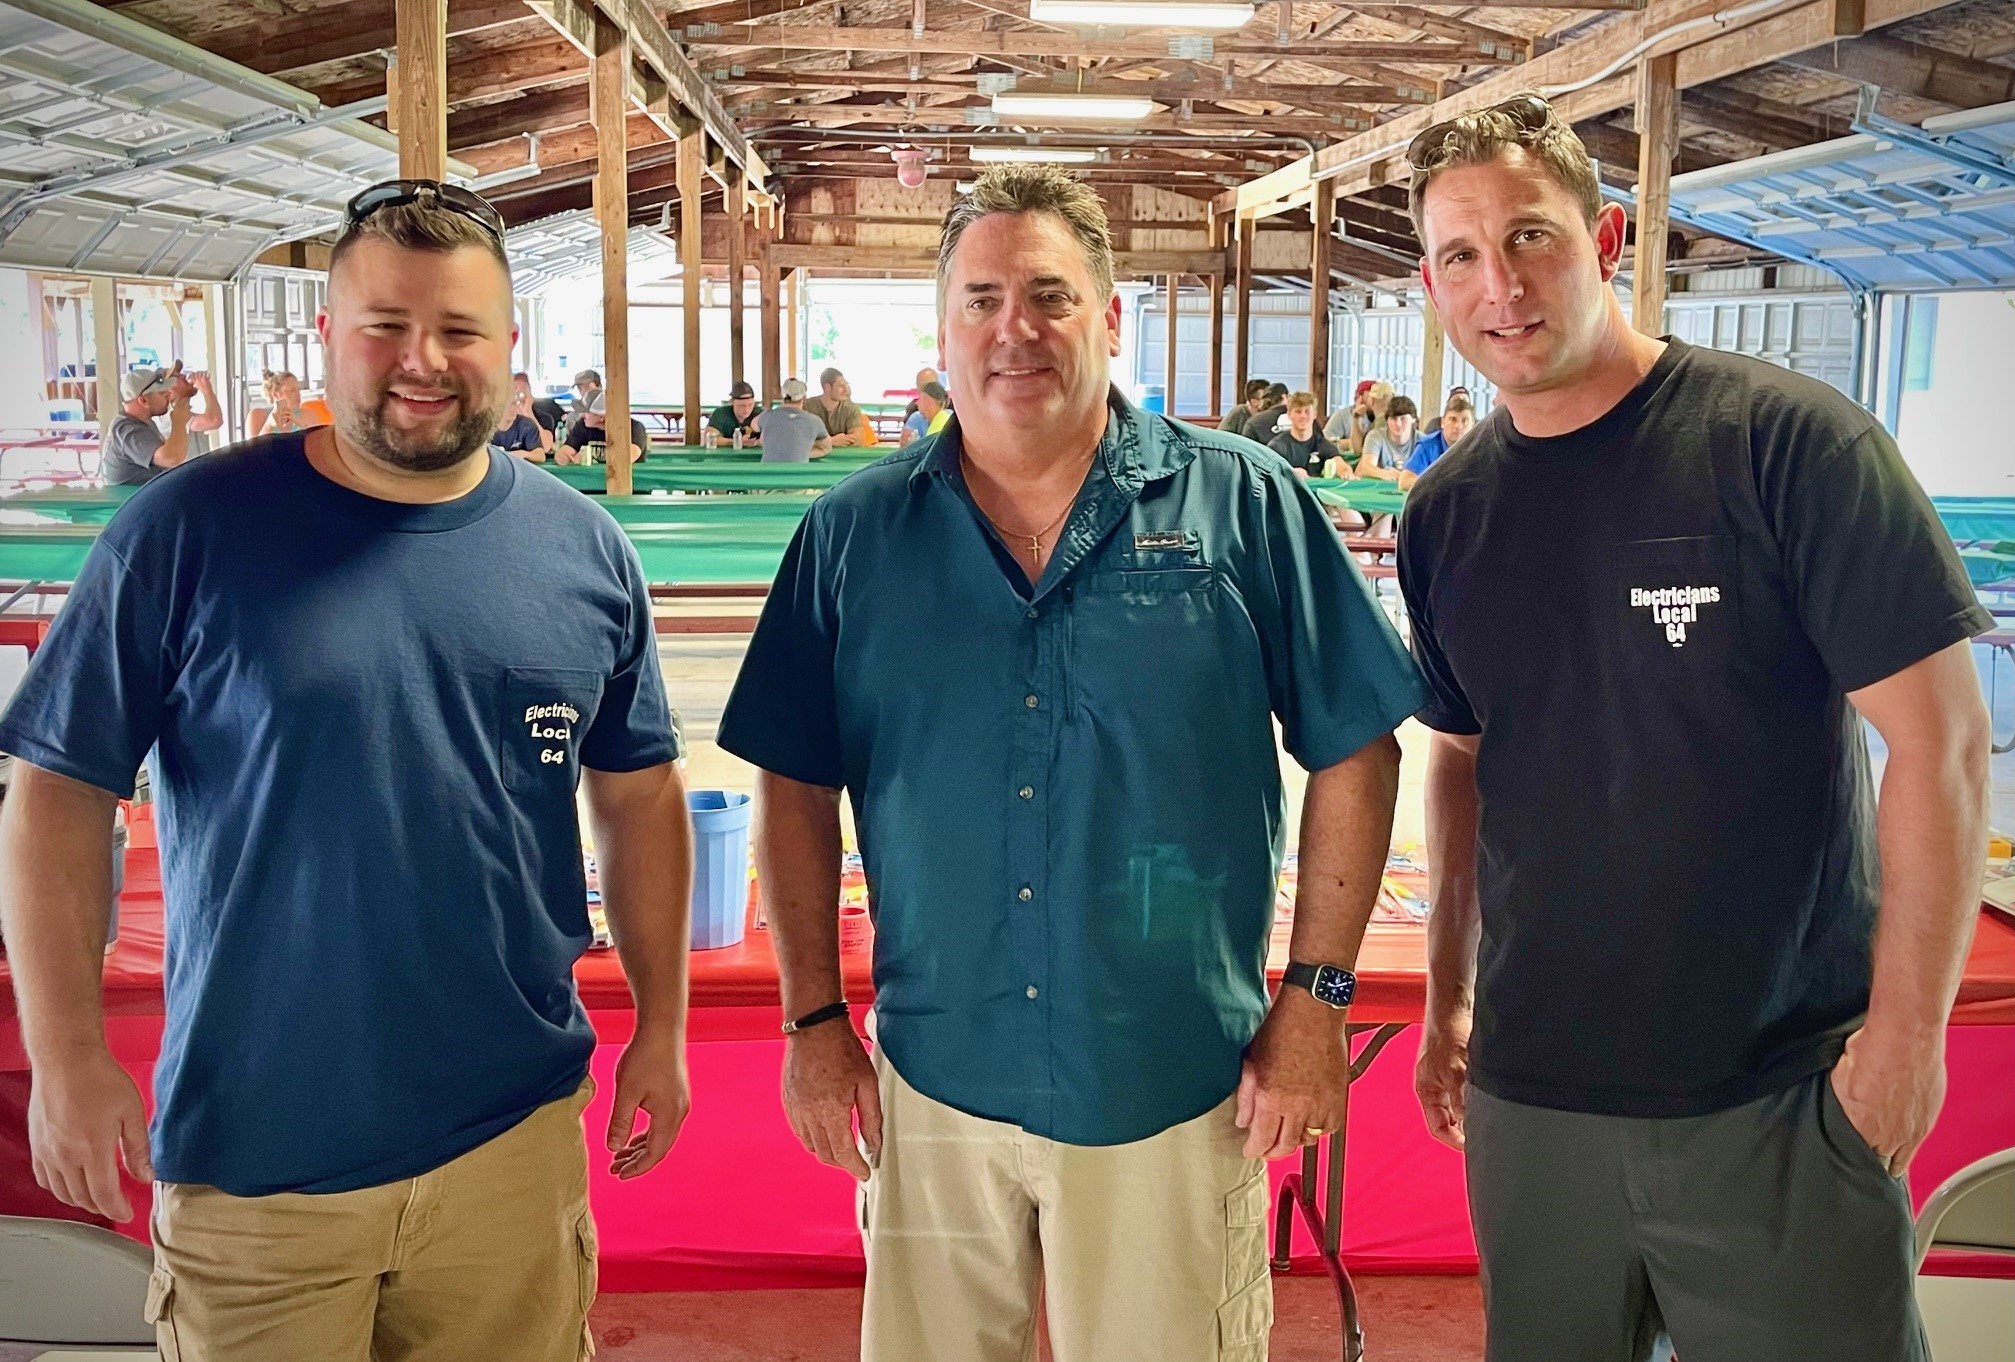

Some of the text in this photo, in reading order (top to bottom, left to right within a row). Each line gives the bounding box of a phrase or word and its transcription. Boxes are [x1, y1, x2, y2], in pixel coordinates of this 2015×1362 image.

[1630, 586, 1721, 607] Electricians
[1652, 604, 1698, 624] Local
[1665, 622, 1687, 643] 64
[540, 749, 564, 764] 64
